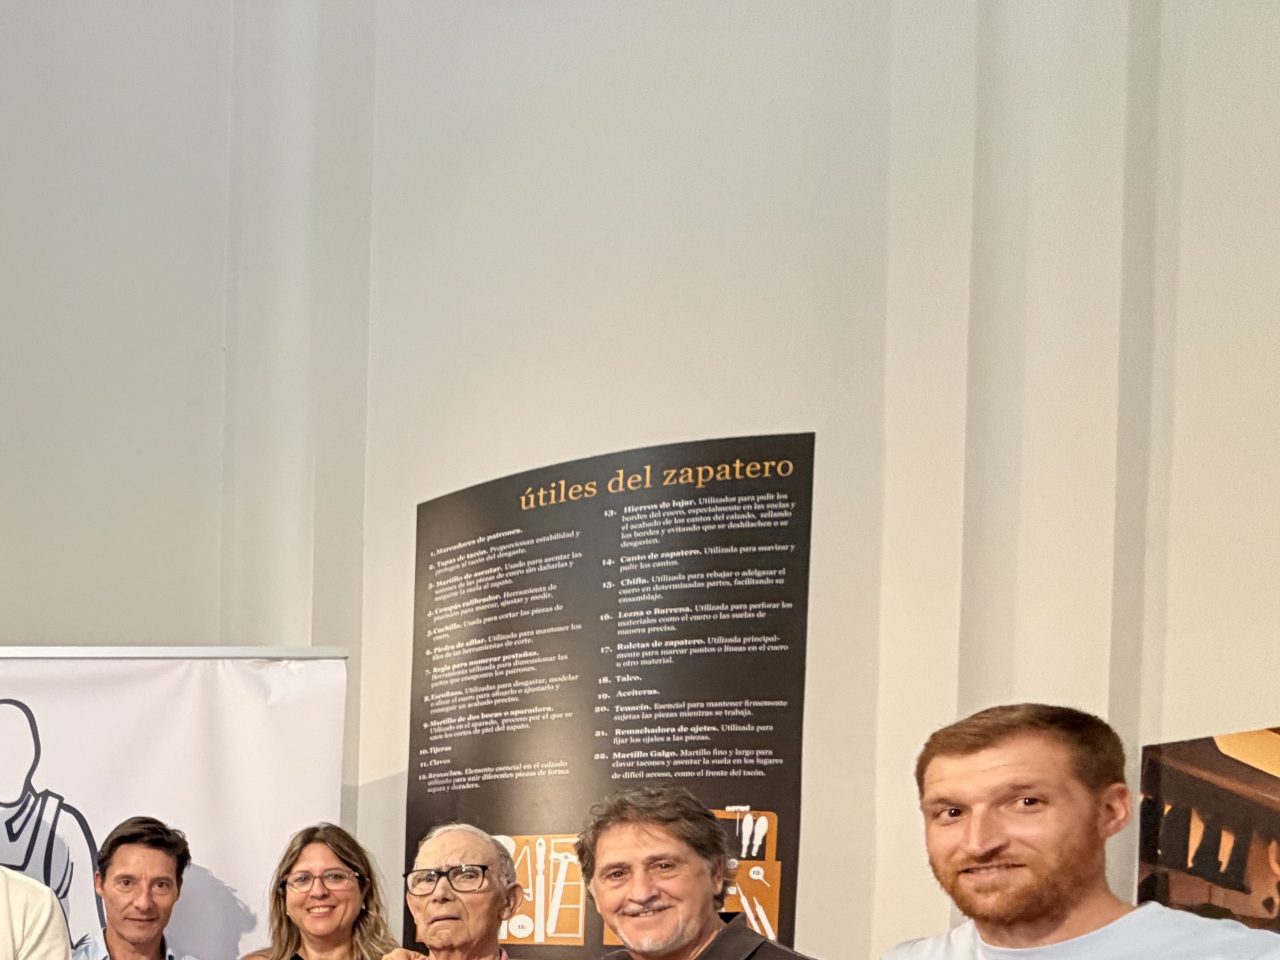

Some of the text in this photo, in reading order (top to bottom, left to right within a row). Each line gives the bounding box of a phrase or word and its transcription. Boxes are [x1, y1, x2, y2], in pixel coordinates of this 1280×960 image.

[519, 459, 794, 512] útiles del zapatero
[616, 688, 660, 697] Aceiteras.
